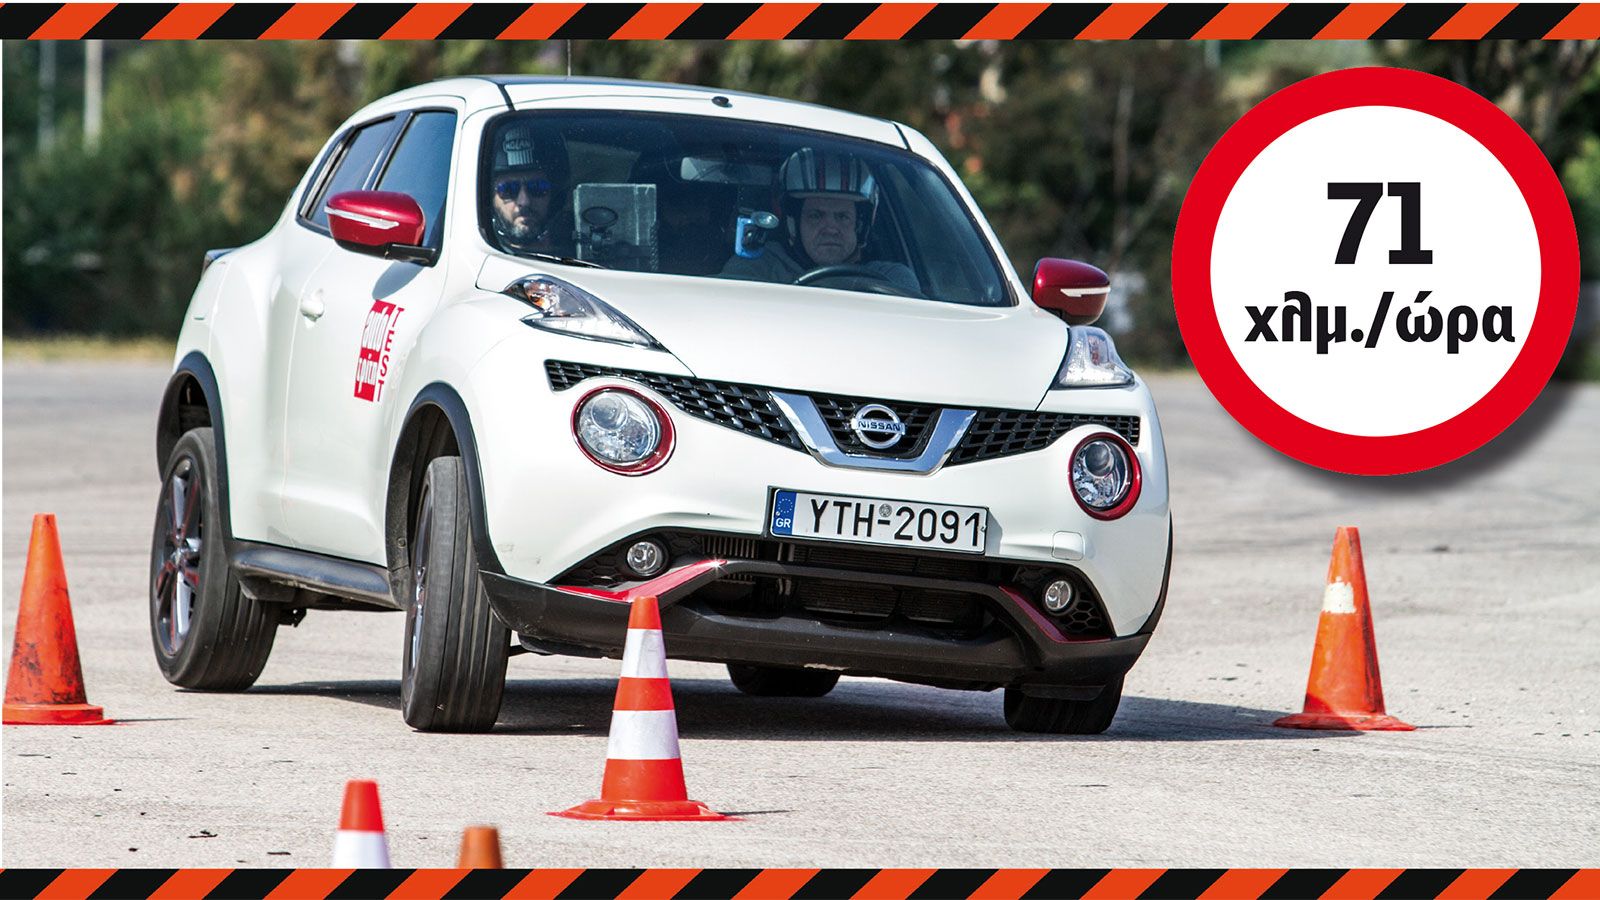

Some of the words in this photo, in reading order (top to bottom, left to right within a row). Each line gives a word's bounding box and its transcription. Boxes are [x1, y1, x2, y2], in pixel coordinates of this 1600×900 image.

[378, 307, 405, 402] TEST
[858, 420, 901, 431] NISSAN
[775, 517, 792, 529] GR
